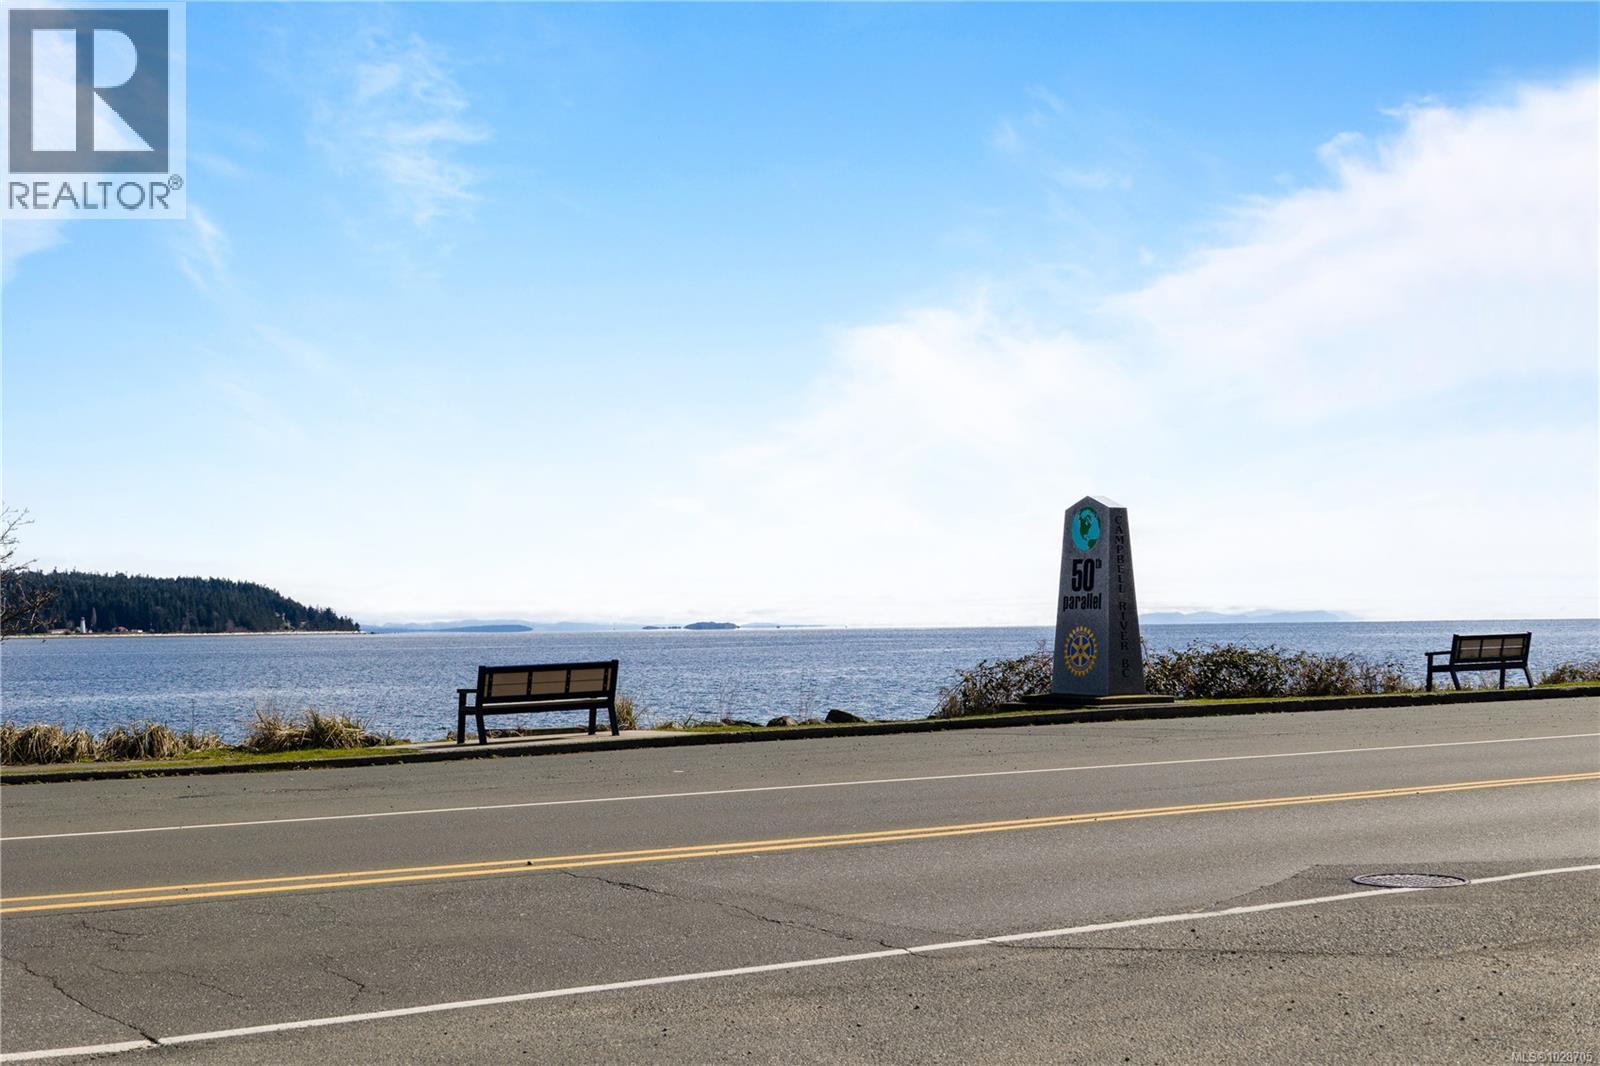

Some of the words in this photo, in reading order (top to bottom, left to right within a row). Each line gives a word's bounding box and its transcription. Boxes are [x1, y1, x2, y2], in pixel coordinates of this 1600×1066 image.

[1114, 516, 1126, 593] CAMPBELL
[1063, 592, 1102, 612] parallel
[1119, 601, 1129, 651] RIVER
[1121, 658, 1130, 678] BC
